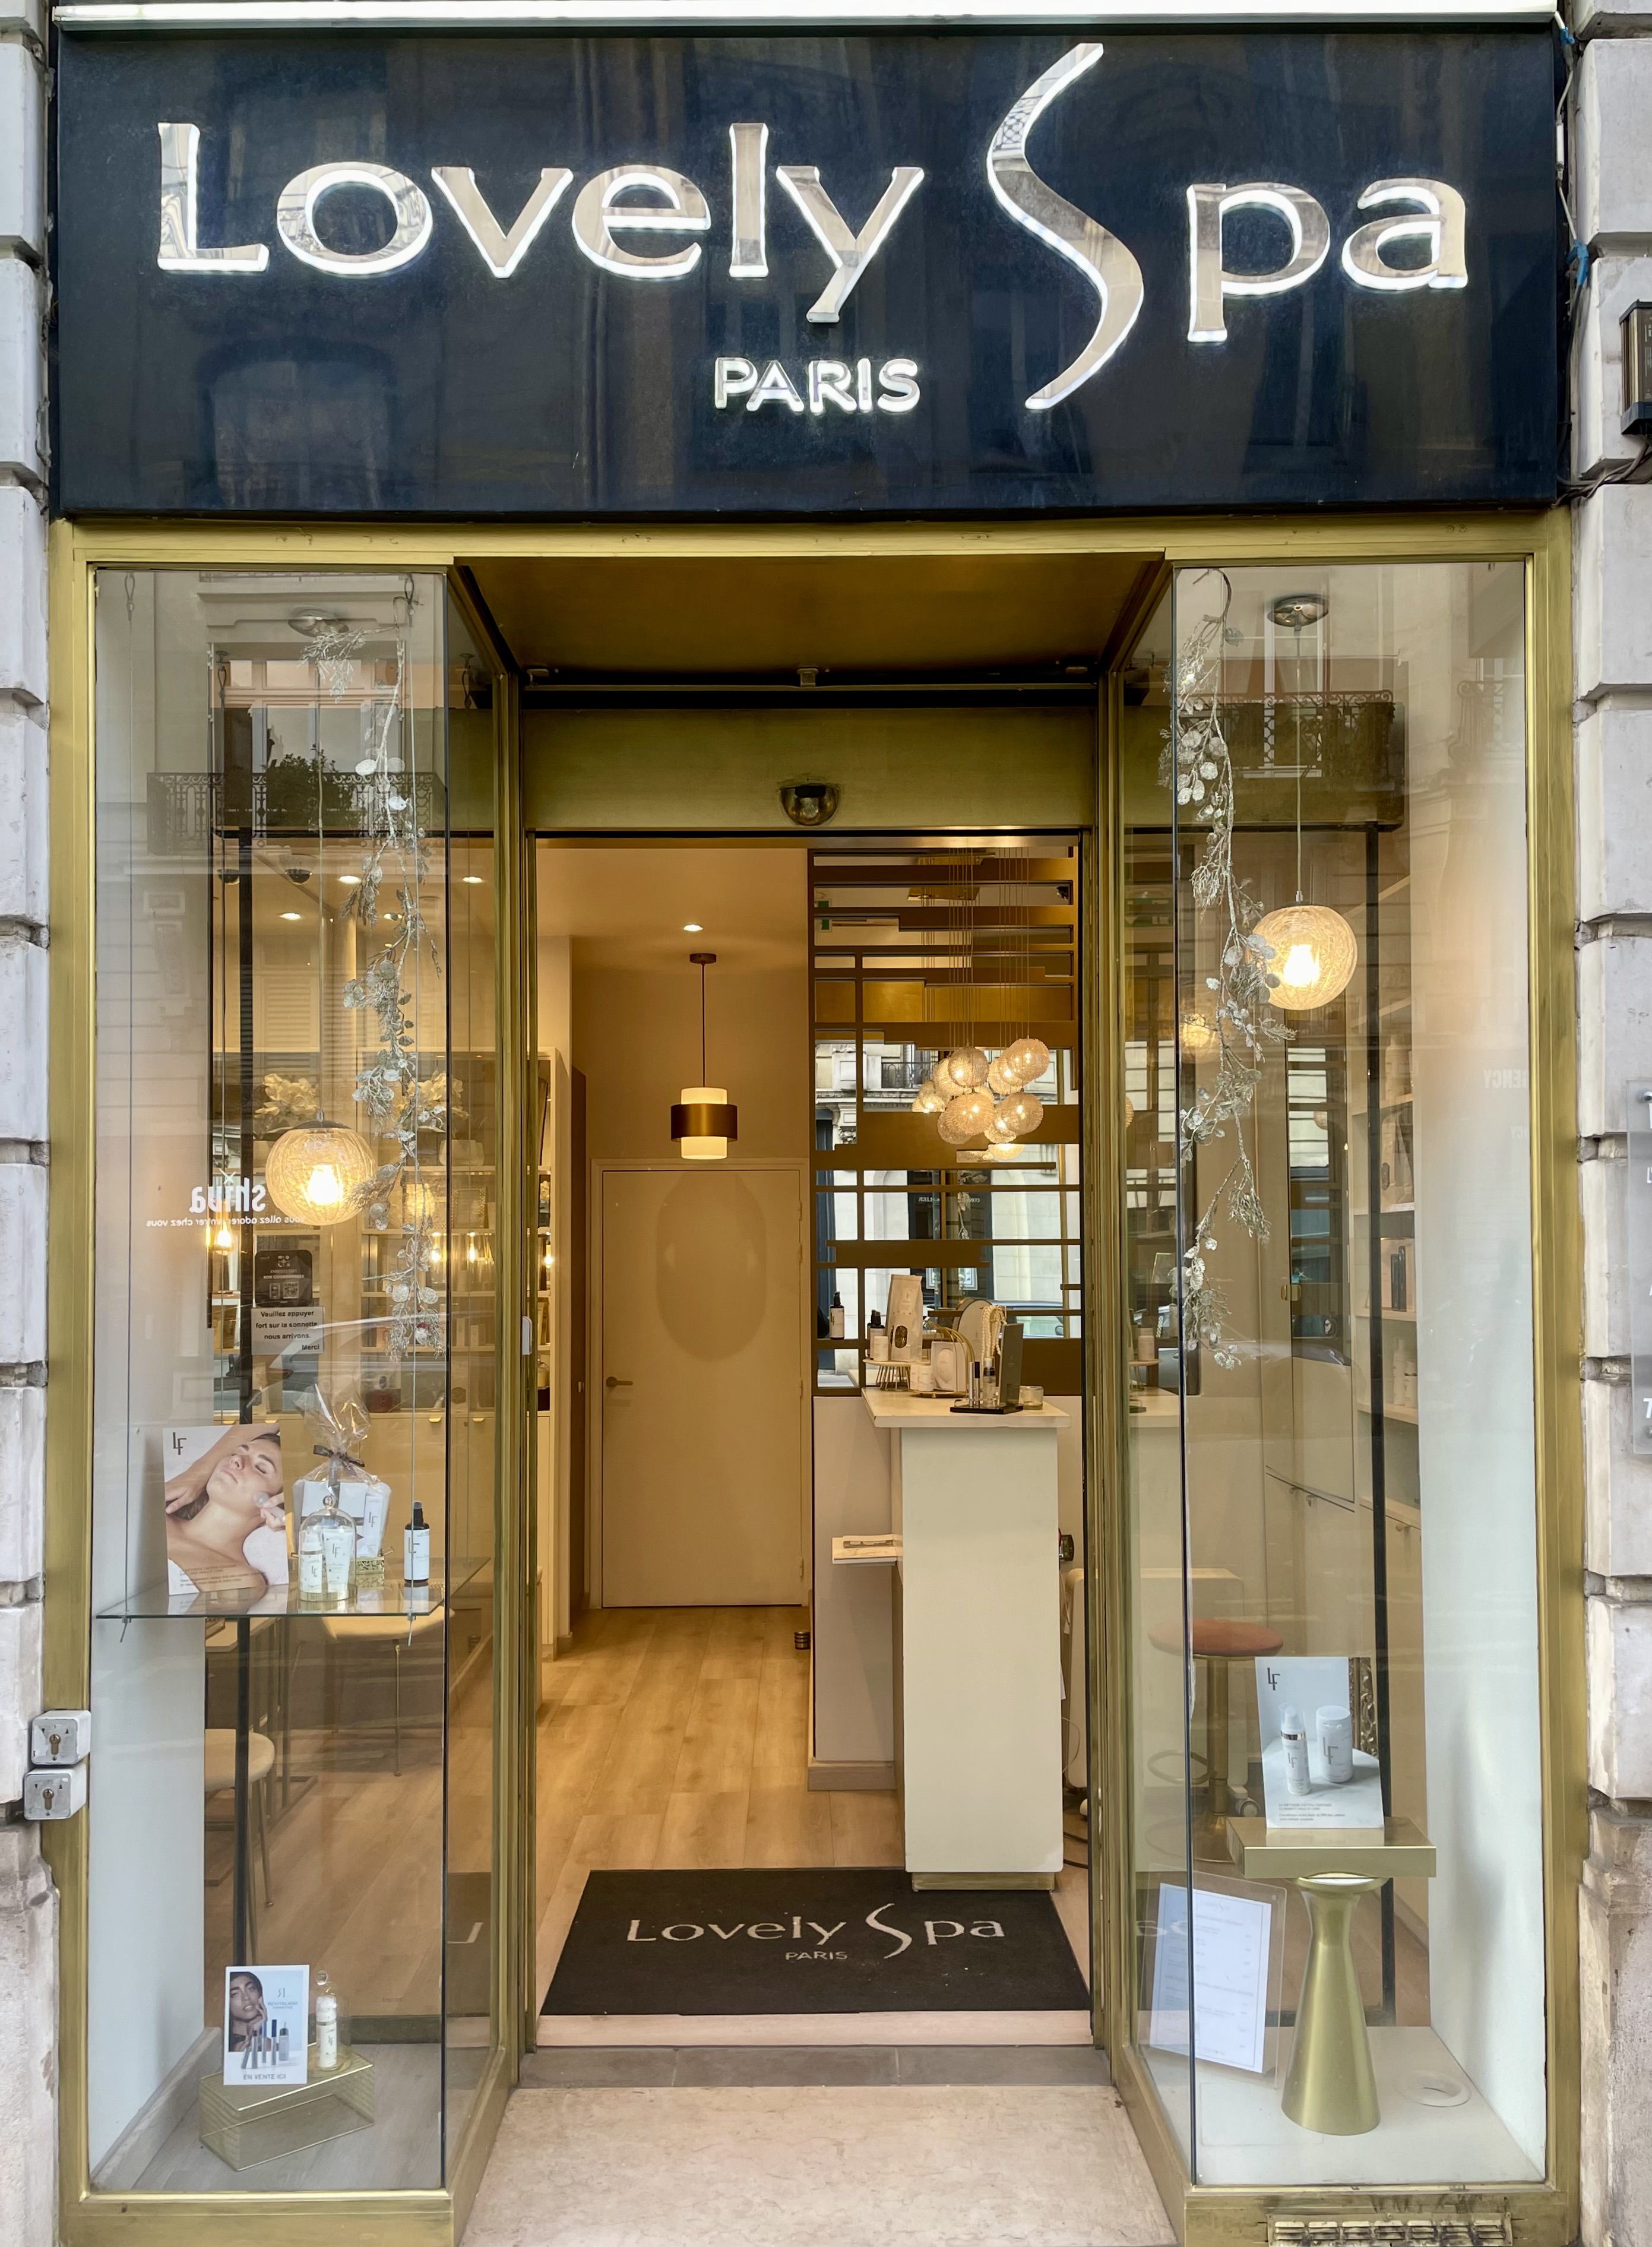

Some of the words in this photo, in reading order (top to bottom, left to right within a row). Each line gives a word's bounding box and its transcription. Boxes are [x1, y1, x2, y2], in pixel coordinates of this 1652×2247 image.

[157, 122, 925, 323] Lovely
[986, 43, 1469, 410] Spa
[714, 357, 920, 414] PARIS
[626, 1916, 846, 1946] Lovely
[865, 1903, 1005, 1959] Spa
[785, 1951, 847, 1960] PARIS
